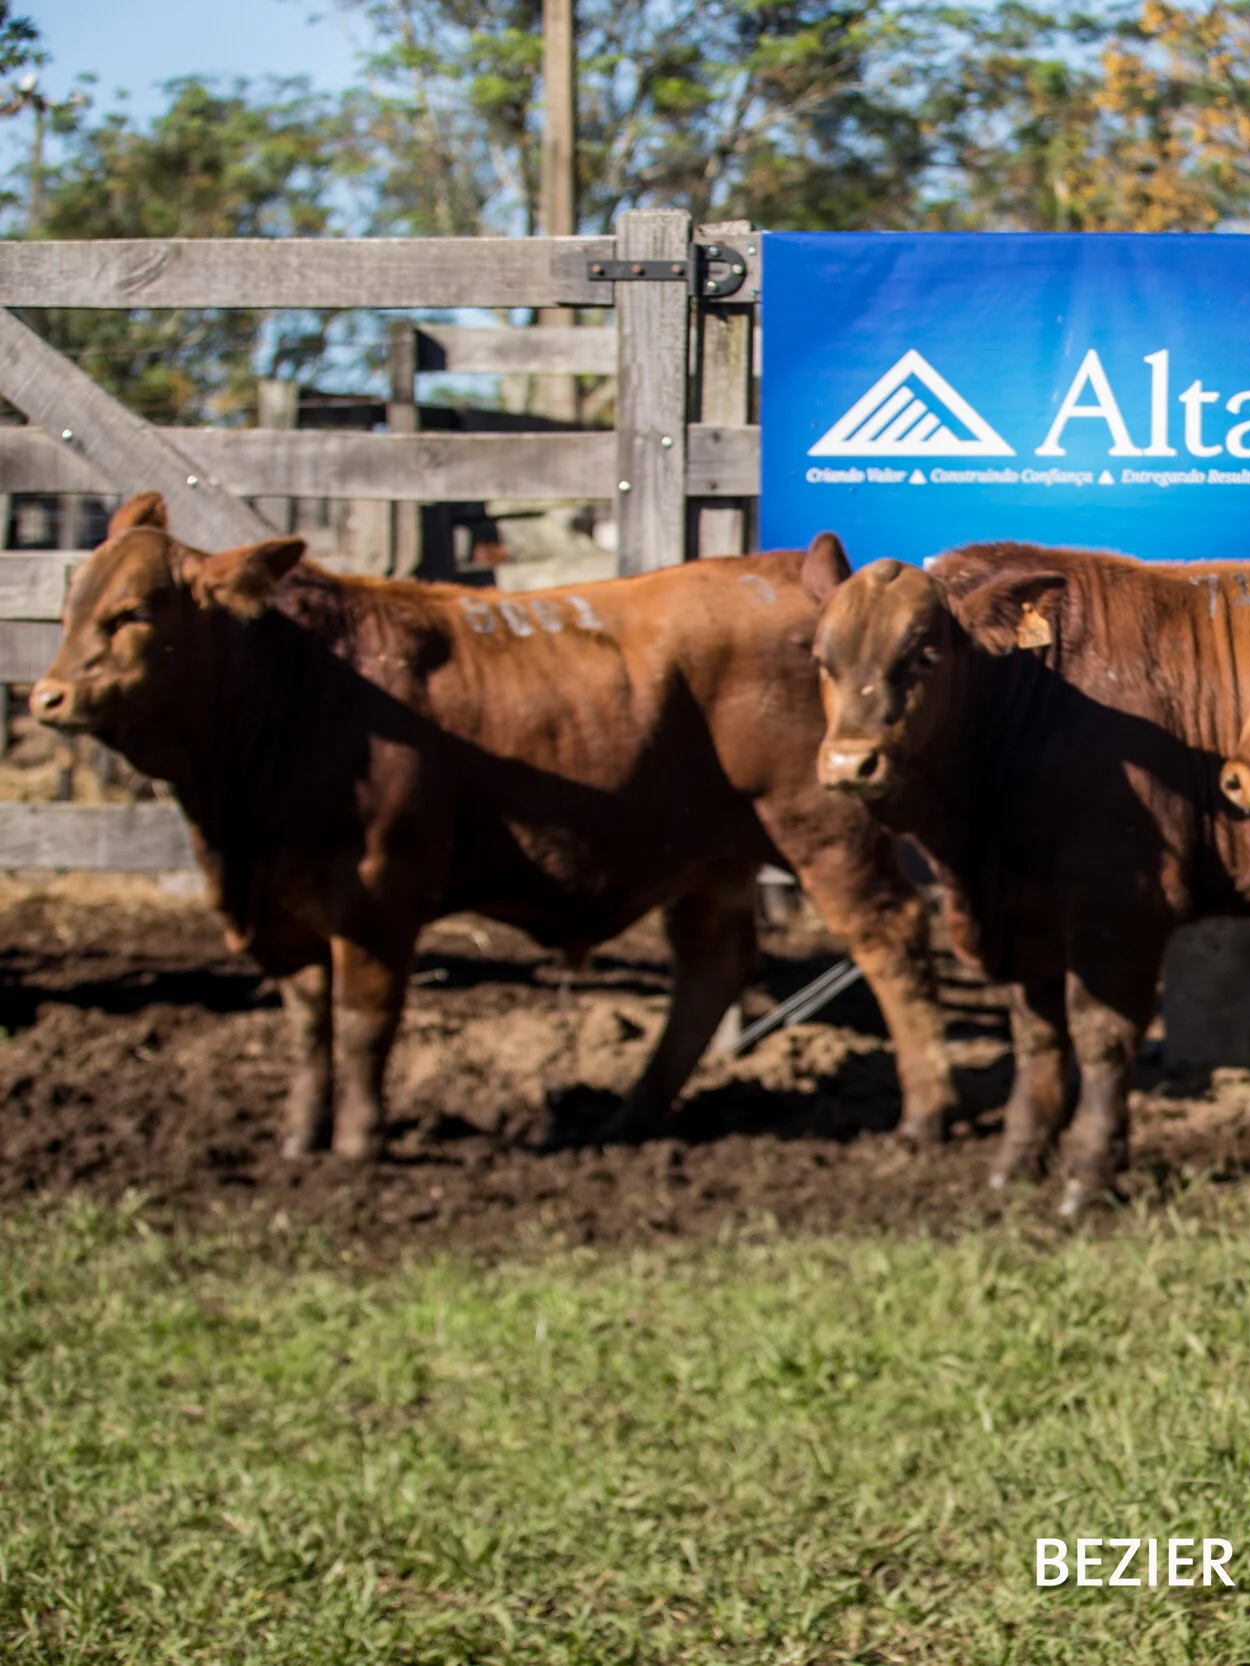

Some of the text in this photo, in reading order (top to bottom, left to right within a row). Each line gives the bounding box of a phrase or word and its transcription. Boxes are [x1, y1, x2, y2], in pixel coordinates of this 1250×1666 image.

[805, 467, 865, 484] Criando
[930, 467, 1019, 484] Construindo
[1020, 467, 1094, 487] Confiança
[1121, 468, 1205, 488] Entregando
